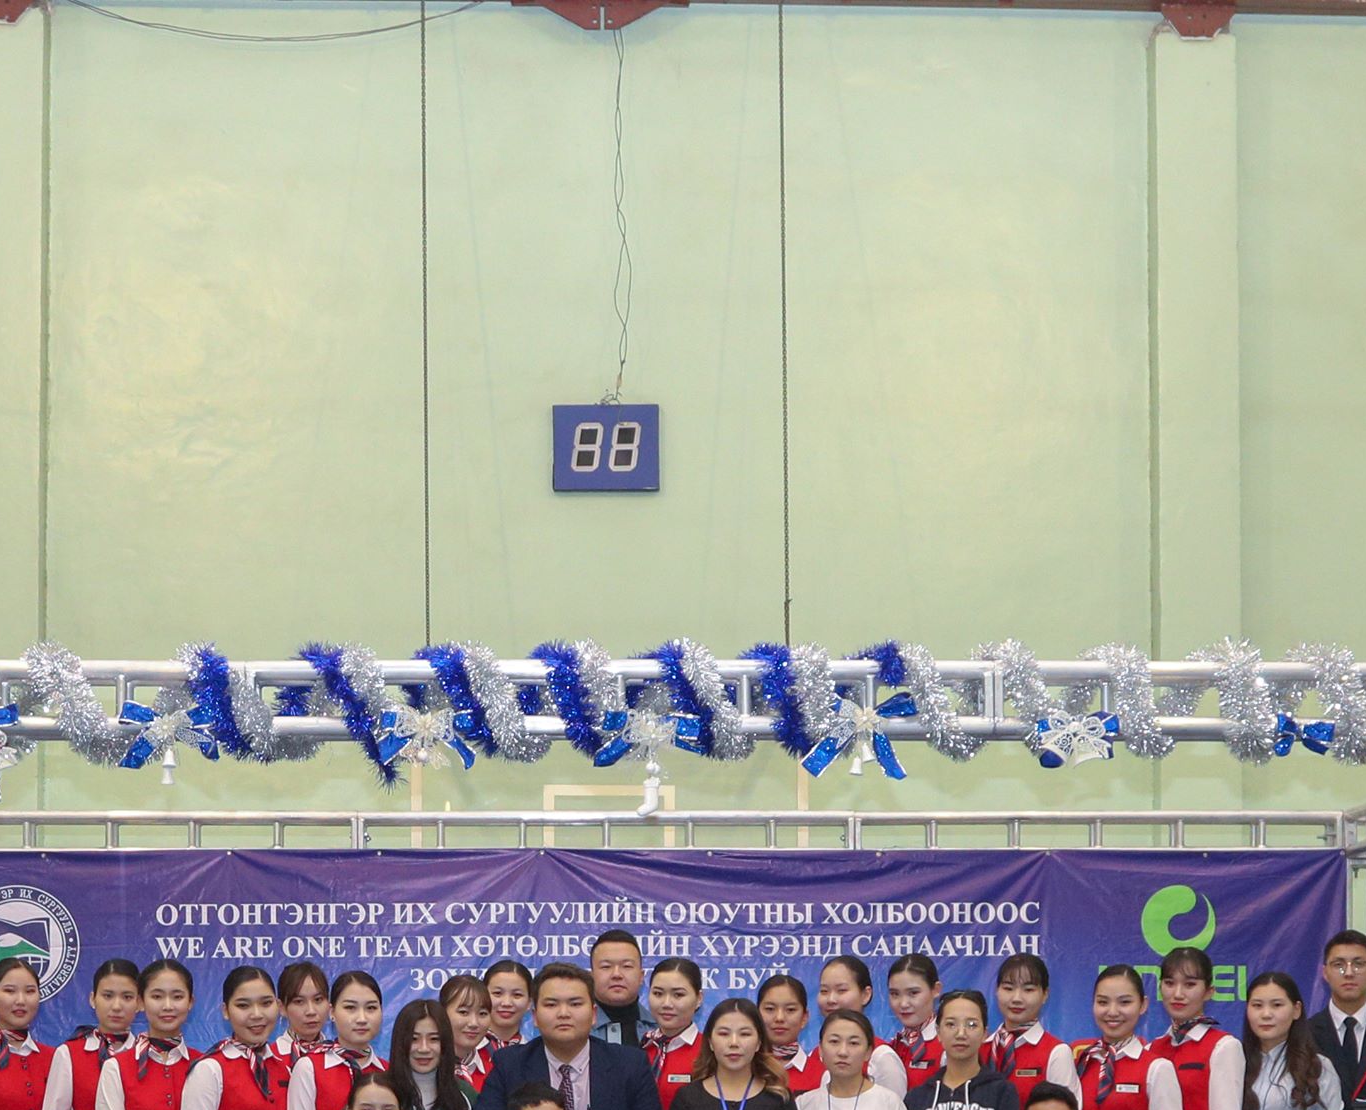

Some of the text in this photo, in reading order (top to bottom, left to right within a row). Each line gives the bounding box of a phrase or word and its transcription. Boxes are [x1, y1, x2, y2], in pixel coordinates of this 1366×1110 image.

[19, 888, 34, 899] ИХ
[37, 891, 71, 934] СУРГУУЛЬ
[156, 897, 1040, 926] ОТГОНТЭНГЭР ИХ СУРГУУЛИЙН ОЮУТНЫ ХОЛБООНООС
[156, 936, 205, 959] WE
[211, 936, 274, 959] ARE
[282, 936, 346, 959] ONE
[354, 935, 443, 958] TEAM
[851, 934, 1040, 957] САНААЧЛАН
